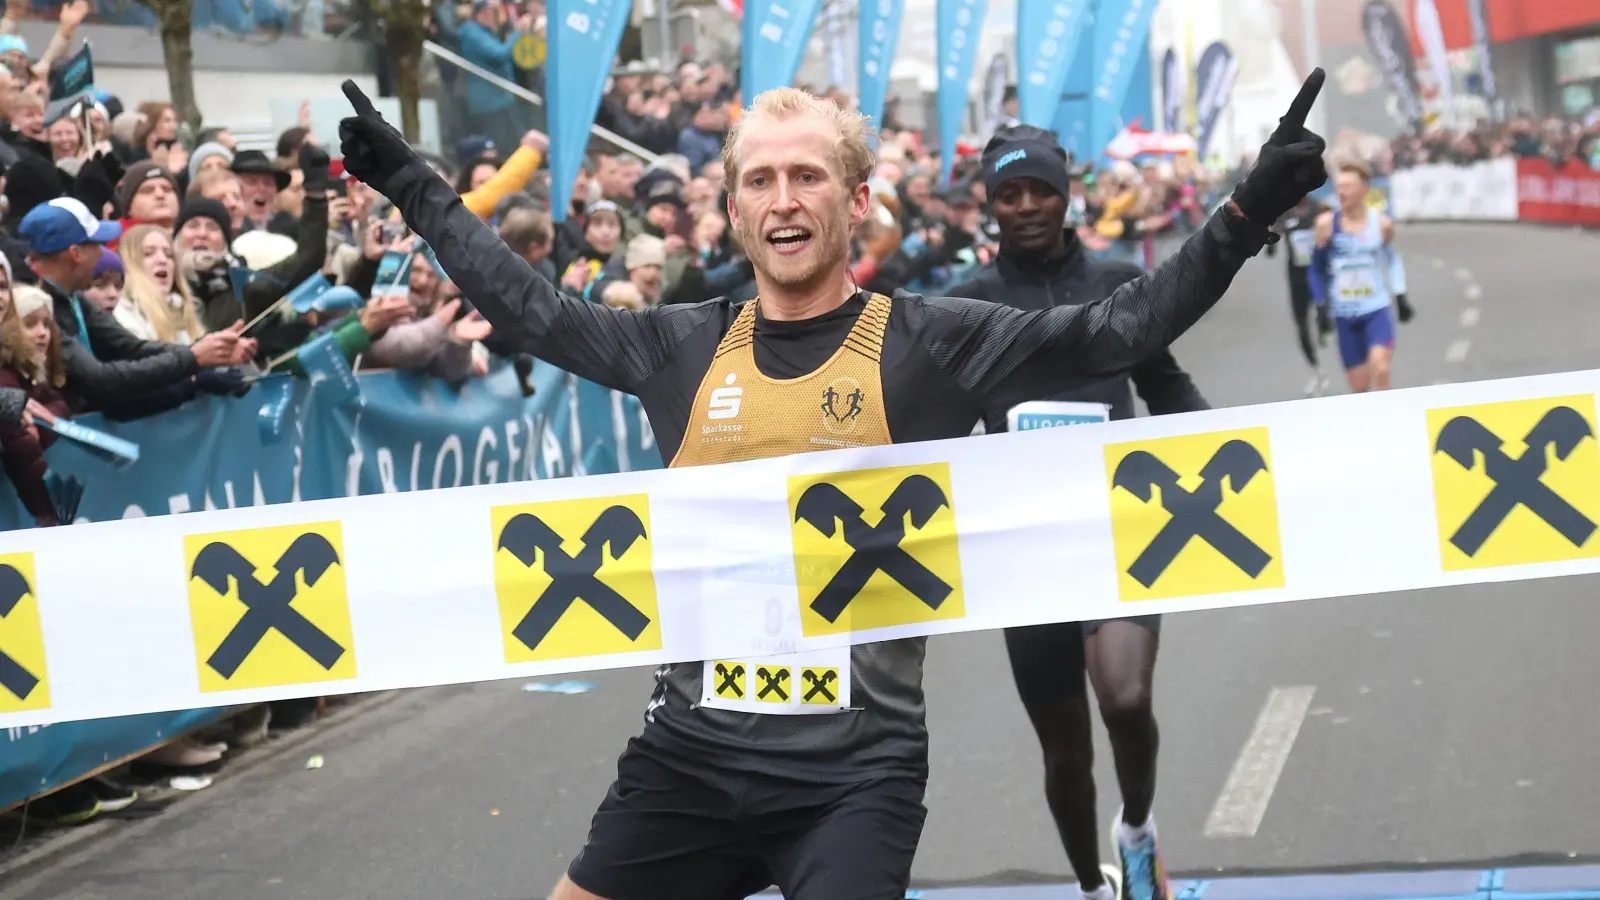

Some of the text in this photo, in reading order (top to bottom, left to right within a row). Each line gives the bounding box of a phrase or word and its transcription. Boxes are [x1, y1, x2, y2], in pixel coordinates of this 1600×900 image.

[994, 148, 1027, 173] HOKA
[702, 424, 744, 435] Sparkasse
[377, 412, 566, 494] BIOGENA
